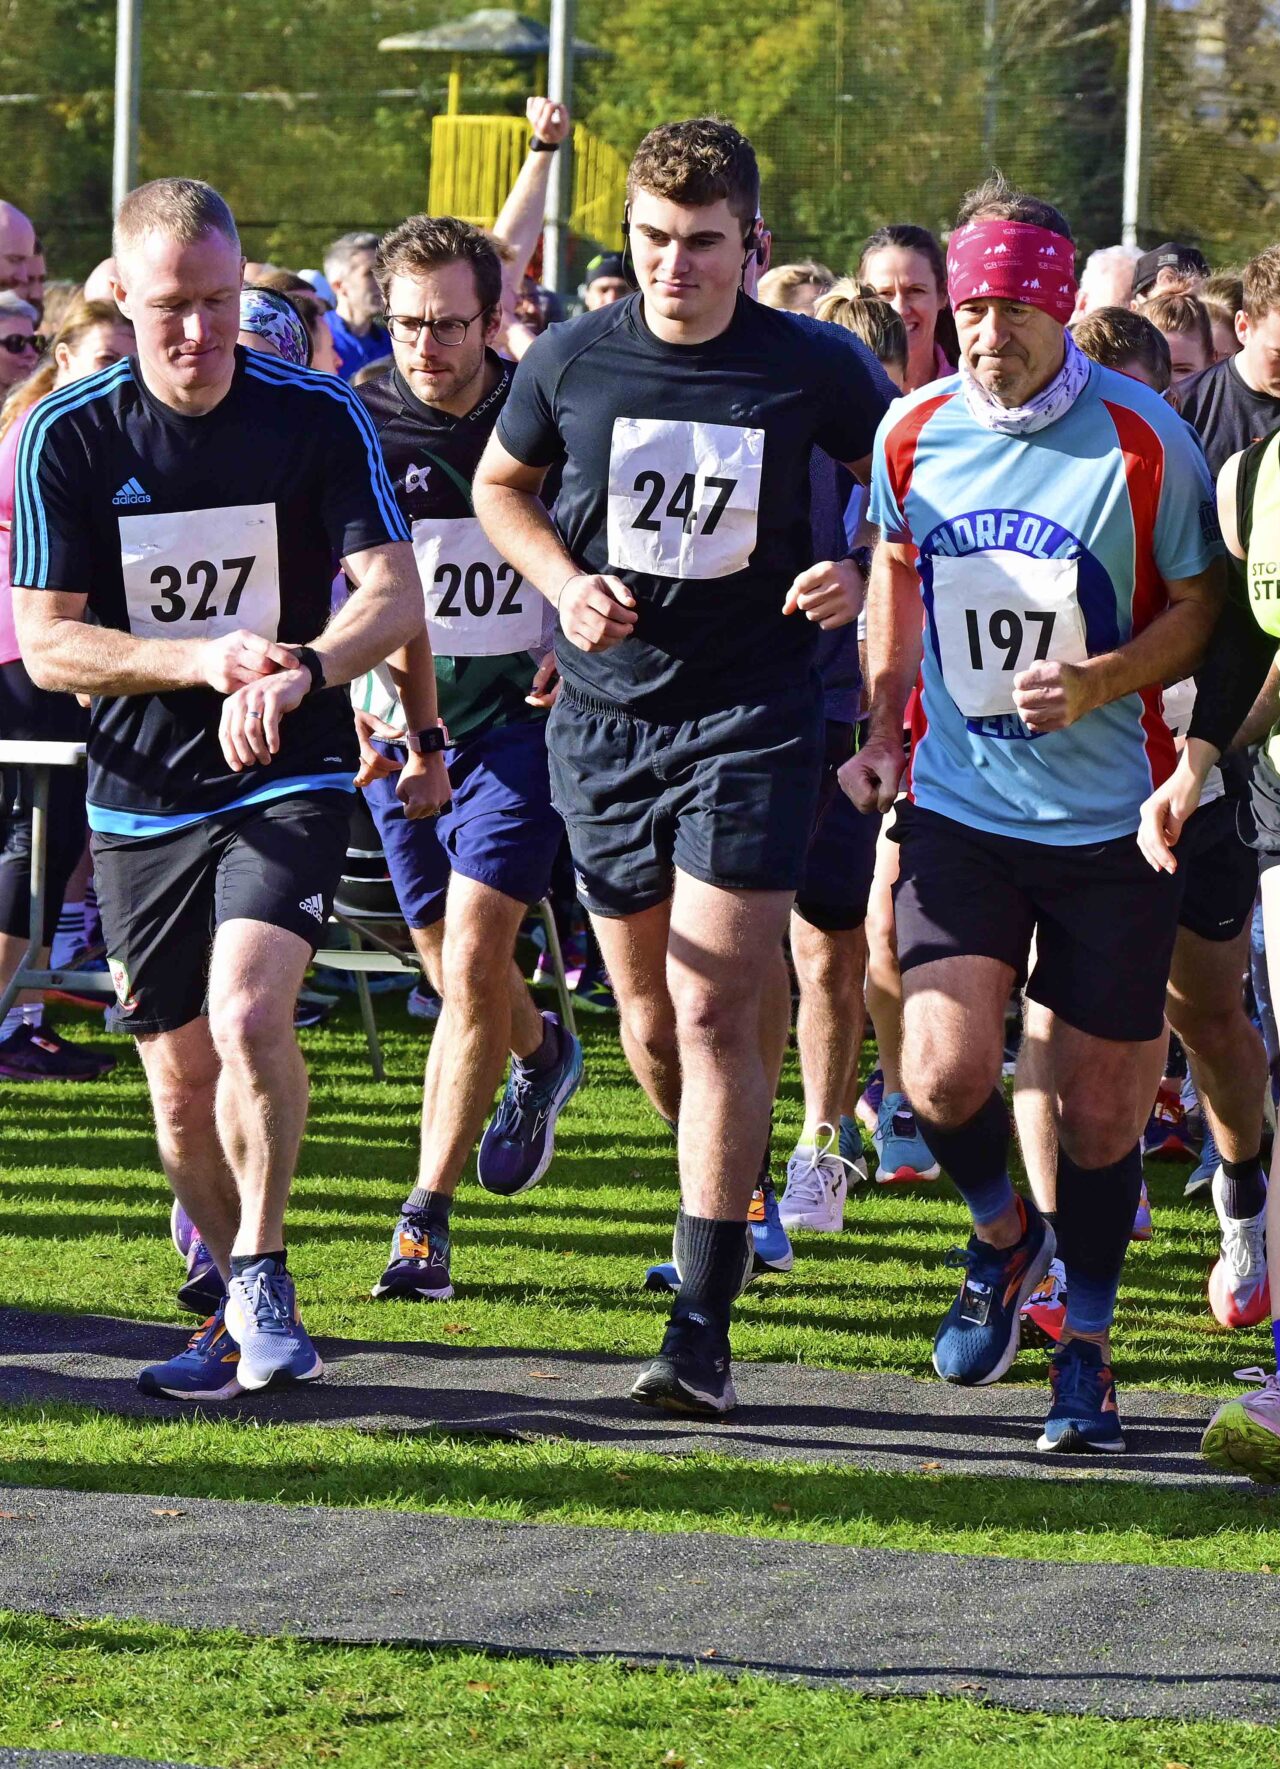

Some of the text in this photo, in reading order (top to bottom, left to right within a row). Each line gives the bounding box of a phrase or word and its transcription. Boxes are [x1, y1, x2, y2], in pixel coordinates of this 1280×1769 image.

[112, 494, 152, 505] adidas
[631, 470, 738, 536] 247
[150, 555, 257, 622] 327
[433, 561, 524, 617] 202
[964, 609, 1057, 671] 197
